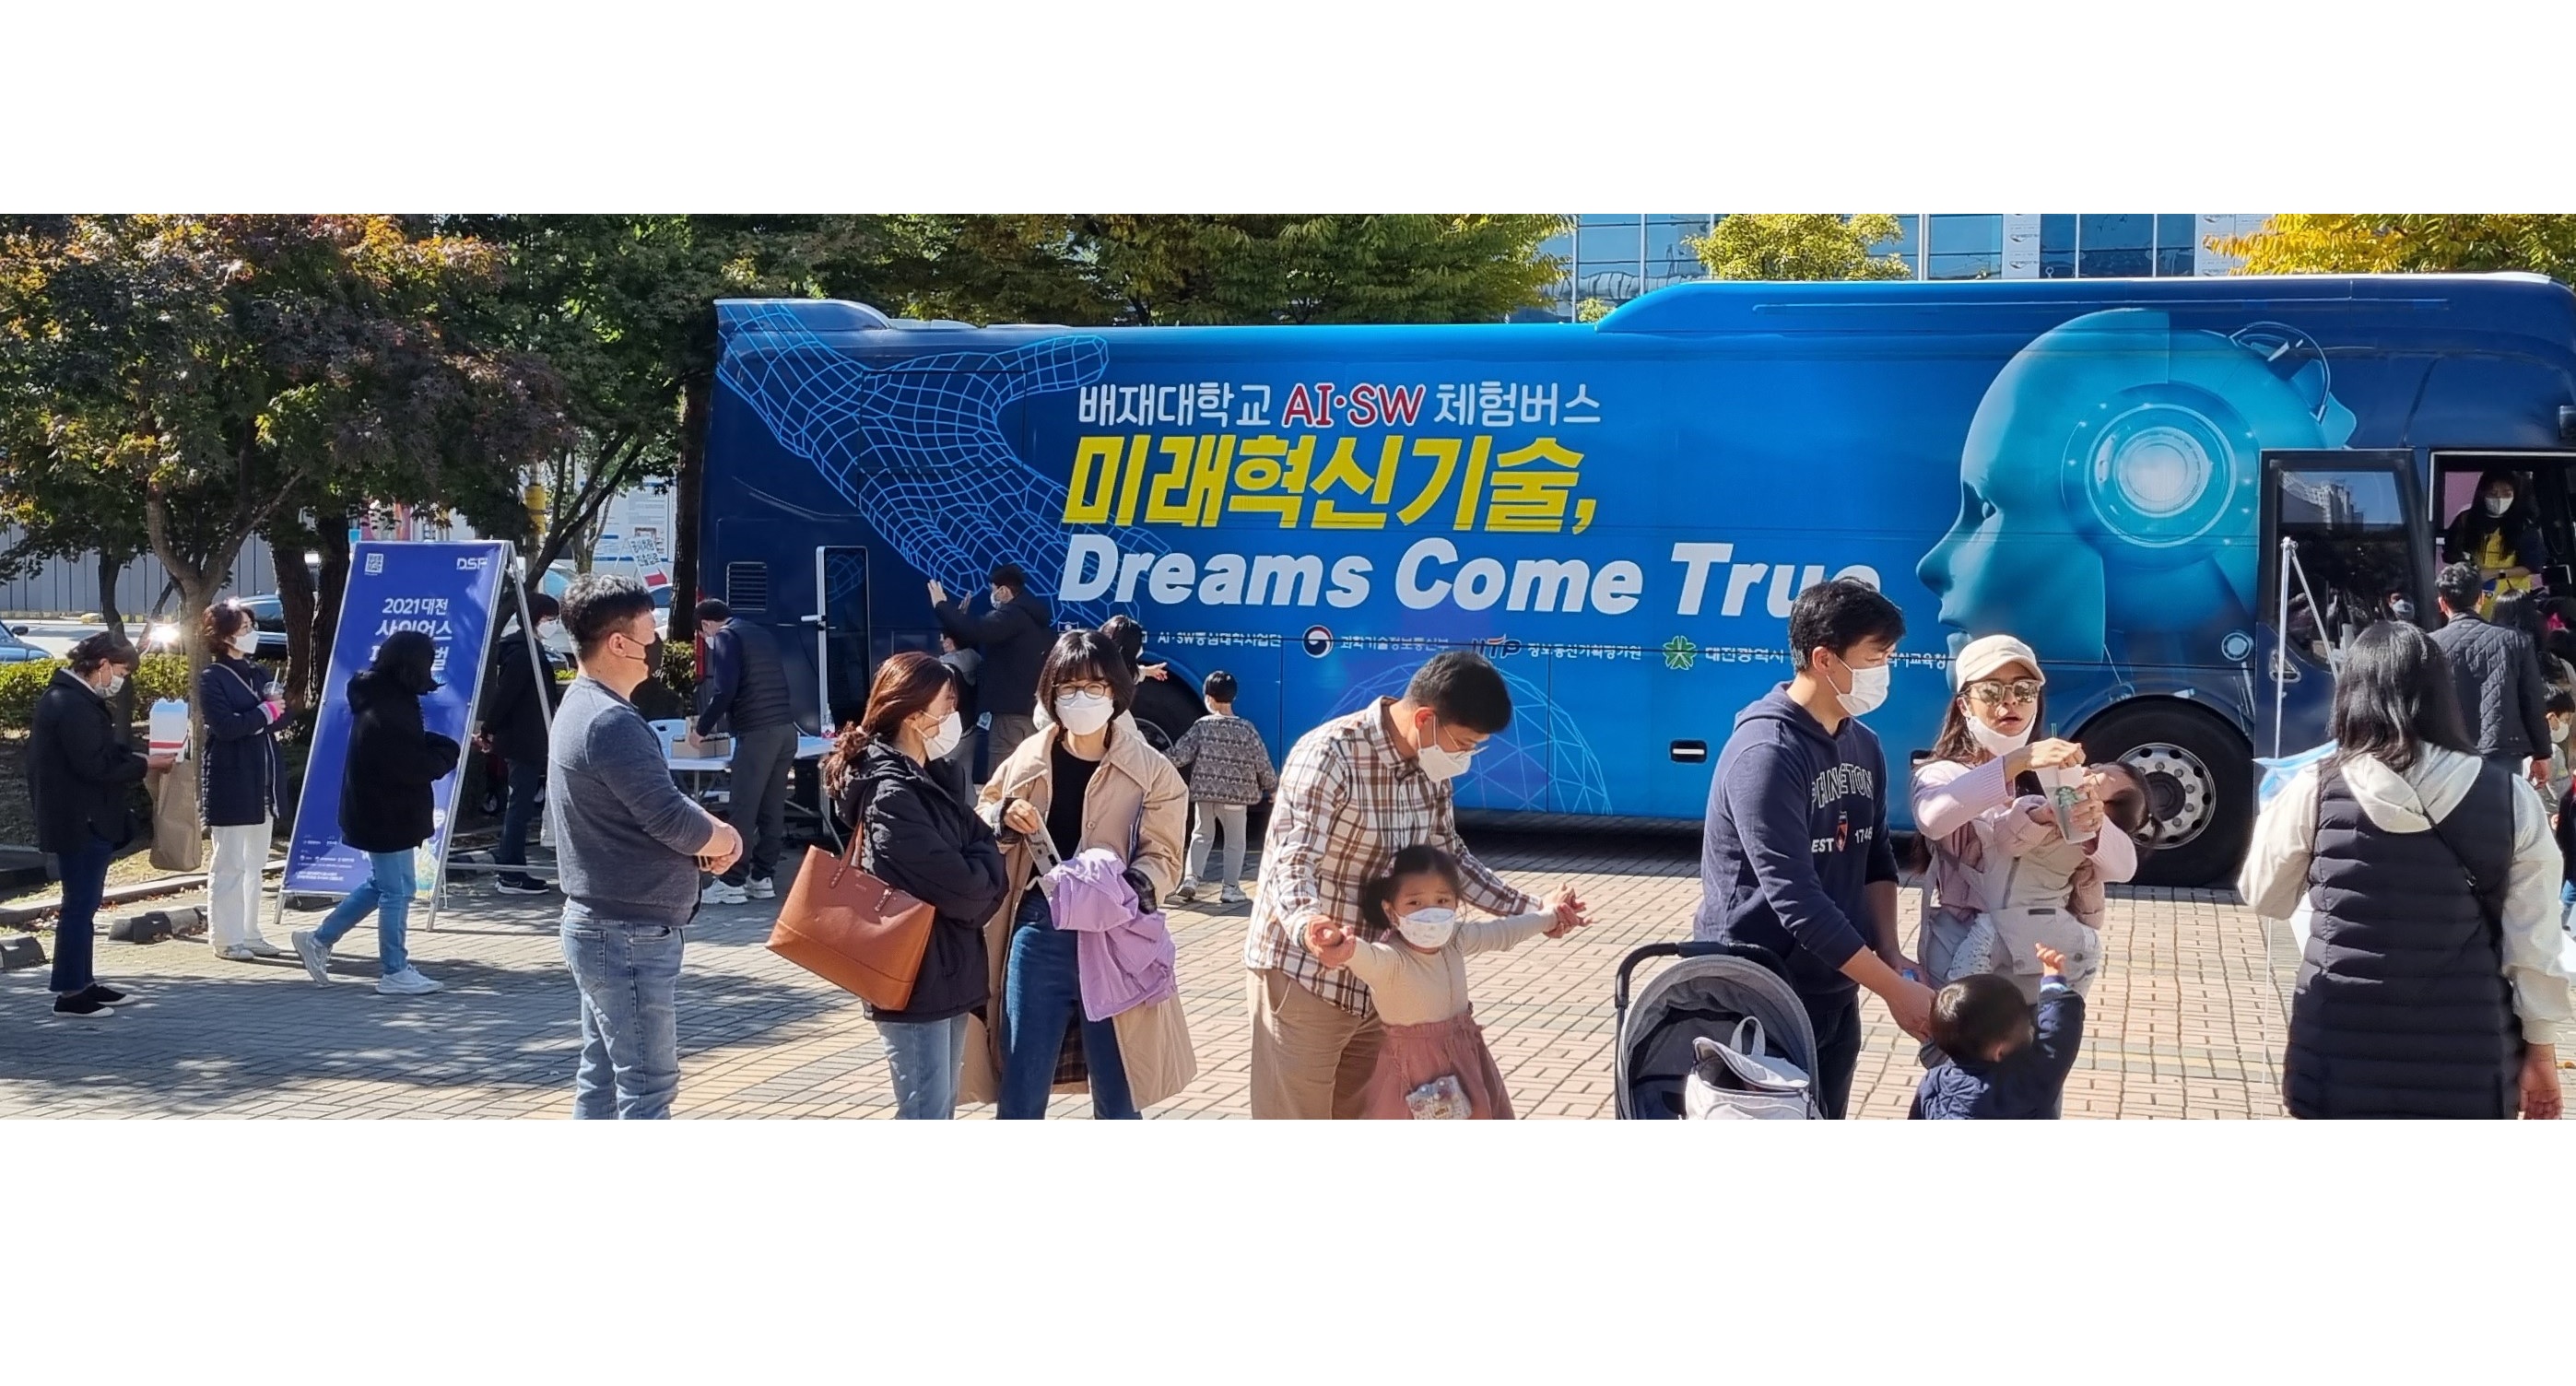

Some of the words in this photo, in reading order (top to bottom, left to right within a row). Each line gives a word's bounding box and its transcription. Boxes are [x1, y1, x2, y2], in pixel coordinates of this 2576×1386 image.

[1077, 382, 1271, 428] 배재대학교
[1434, 381, 1602, 427] 체험버스
[1061, 434, 1597, 535] 미래혁신기술,
[1057, 534, 1374, 606] Dreams
[1395, 536, 1643, 616] Come
[1705, 647, 1785, 664] 대전광역시
[1811, 837, 1835, 853] EST
